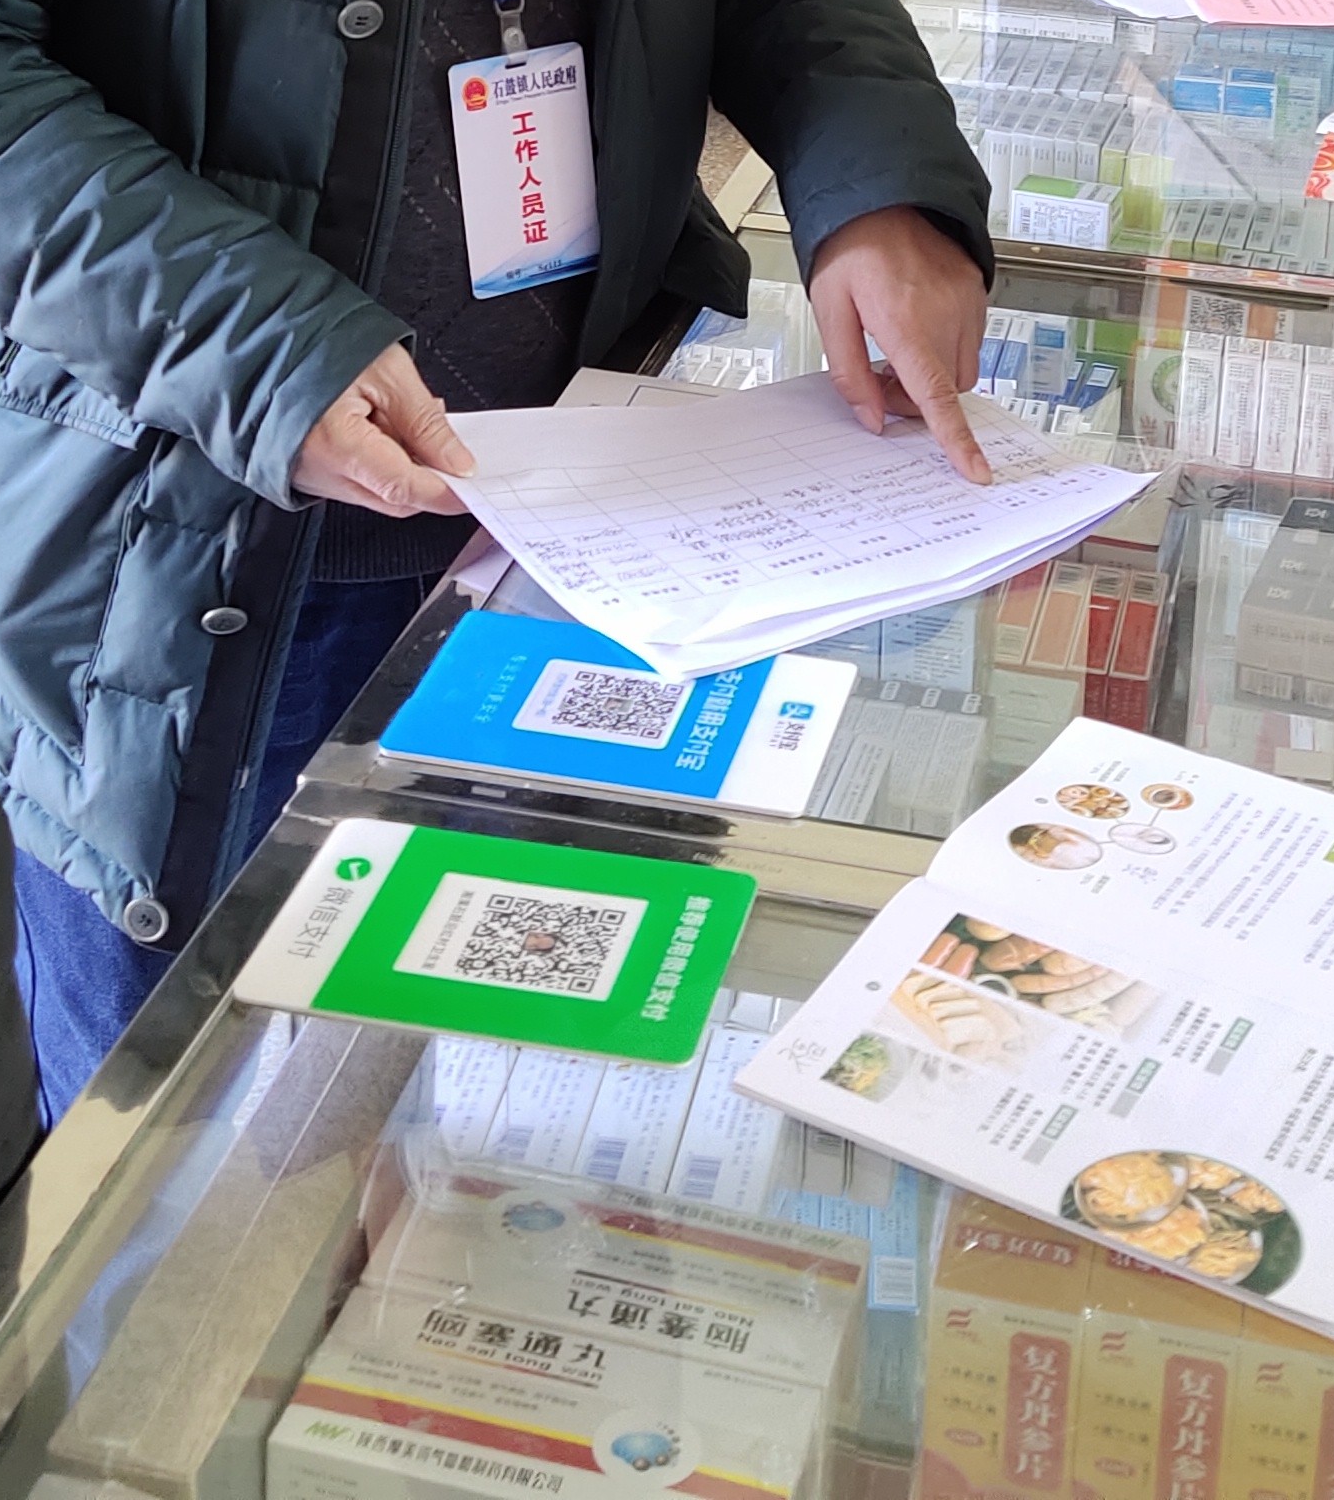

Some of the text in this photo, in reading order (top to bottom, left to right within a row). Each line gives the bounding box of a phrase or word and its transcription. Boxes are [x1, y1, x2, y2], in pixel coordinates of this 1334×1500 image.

[512, 112, 548, 244] 工作人员证
[287, 886, 343, 959] 微信支付
[640, 895, 712, 1022] 推荐使用微信支付
[419, 1309, 606, 1370] 脑塞通丸
[567, 1288, 750, 1355] 脑塞通丸
[504, 1349, 551, 1372] tong
[1016, 1345, 1059, 1480] 复方丹参片
